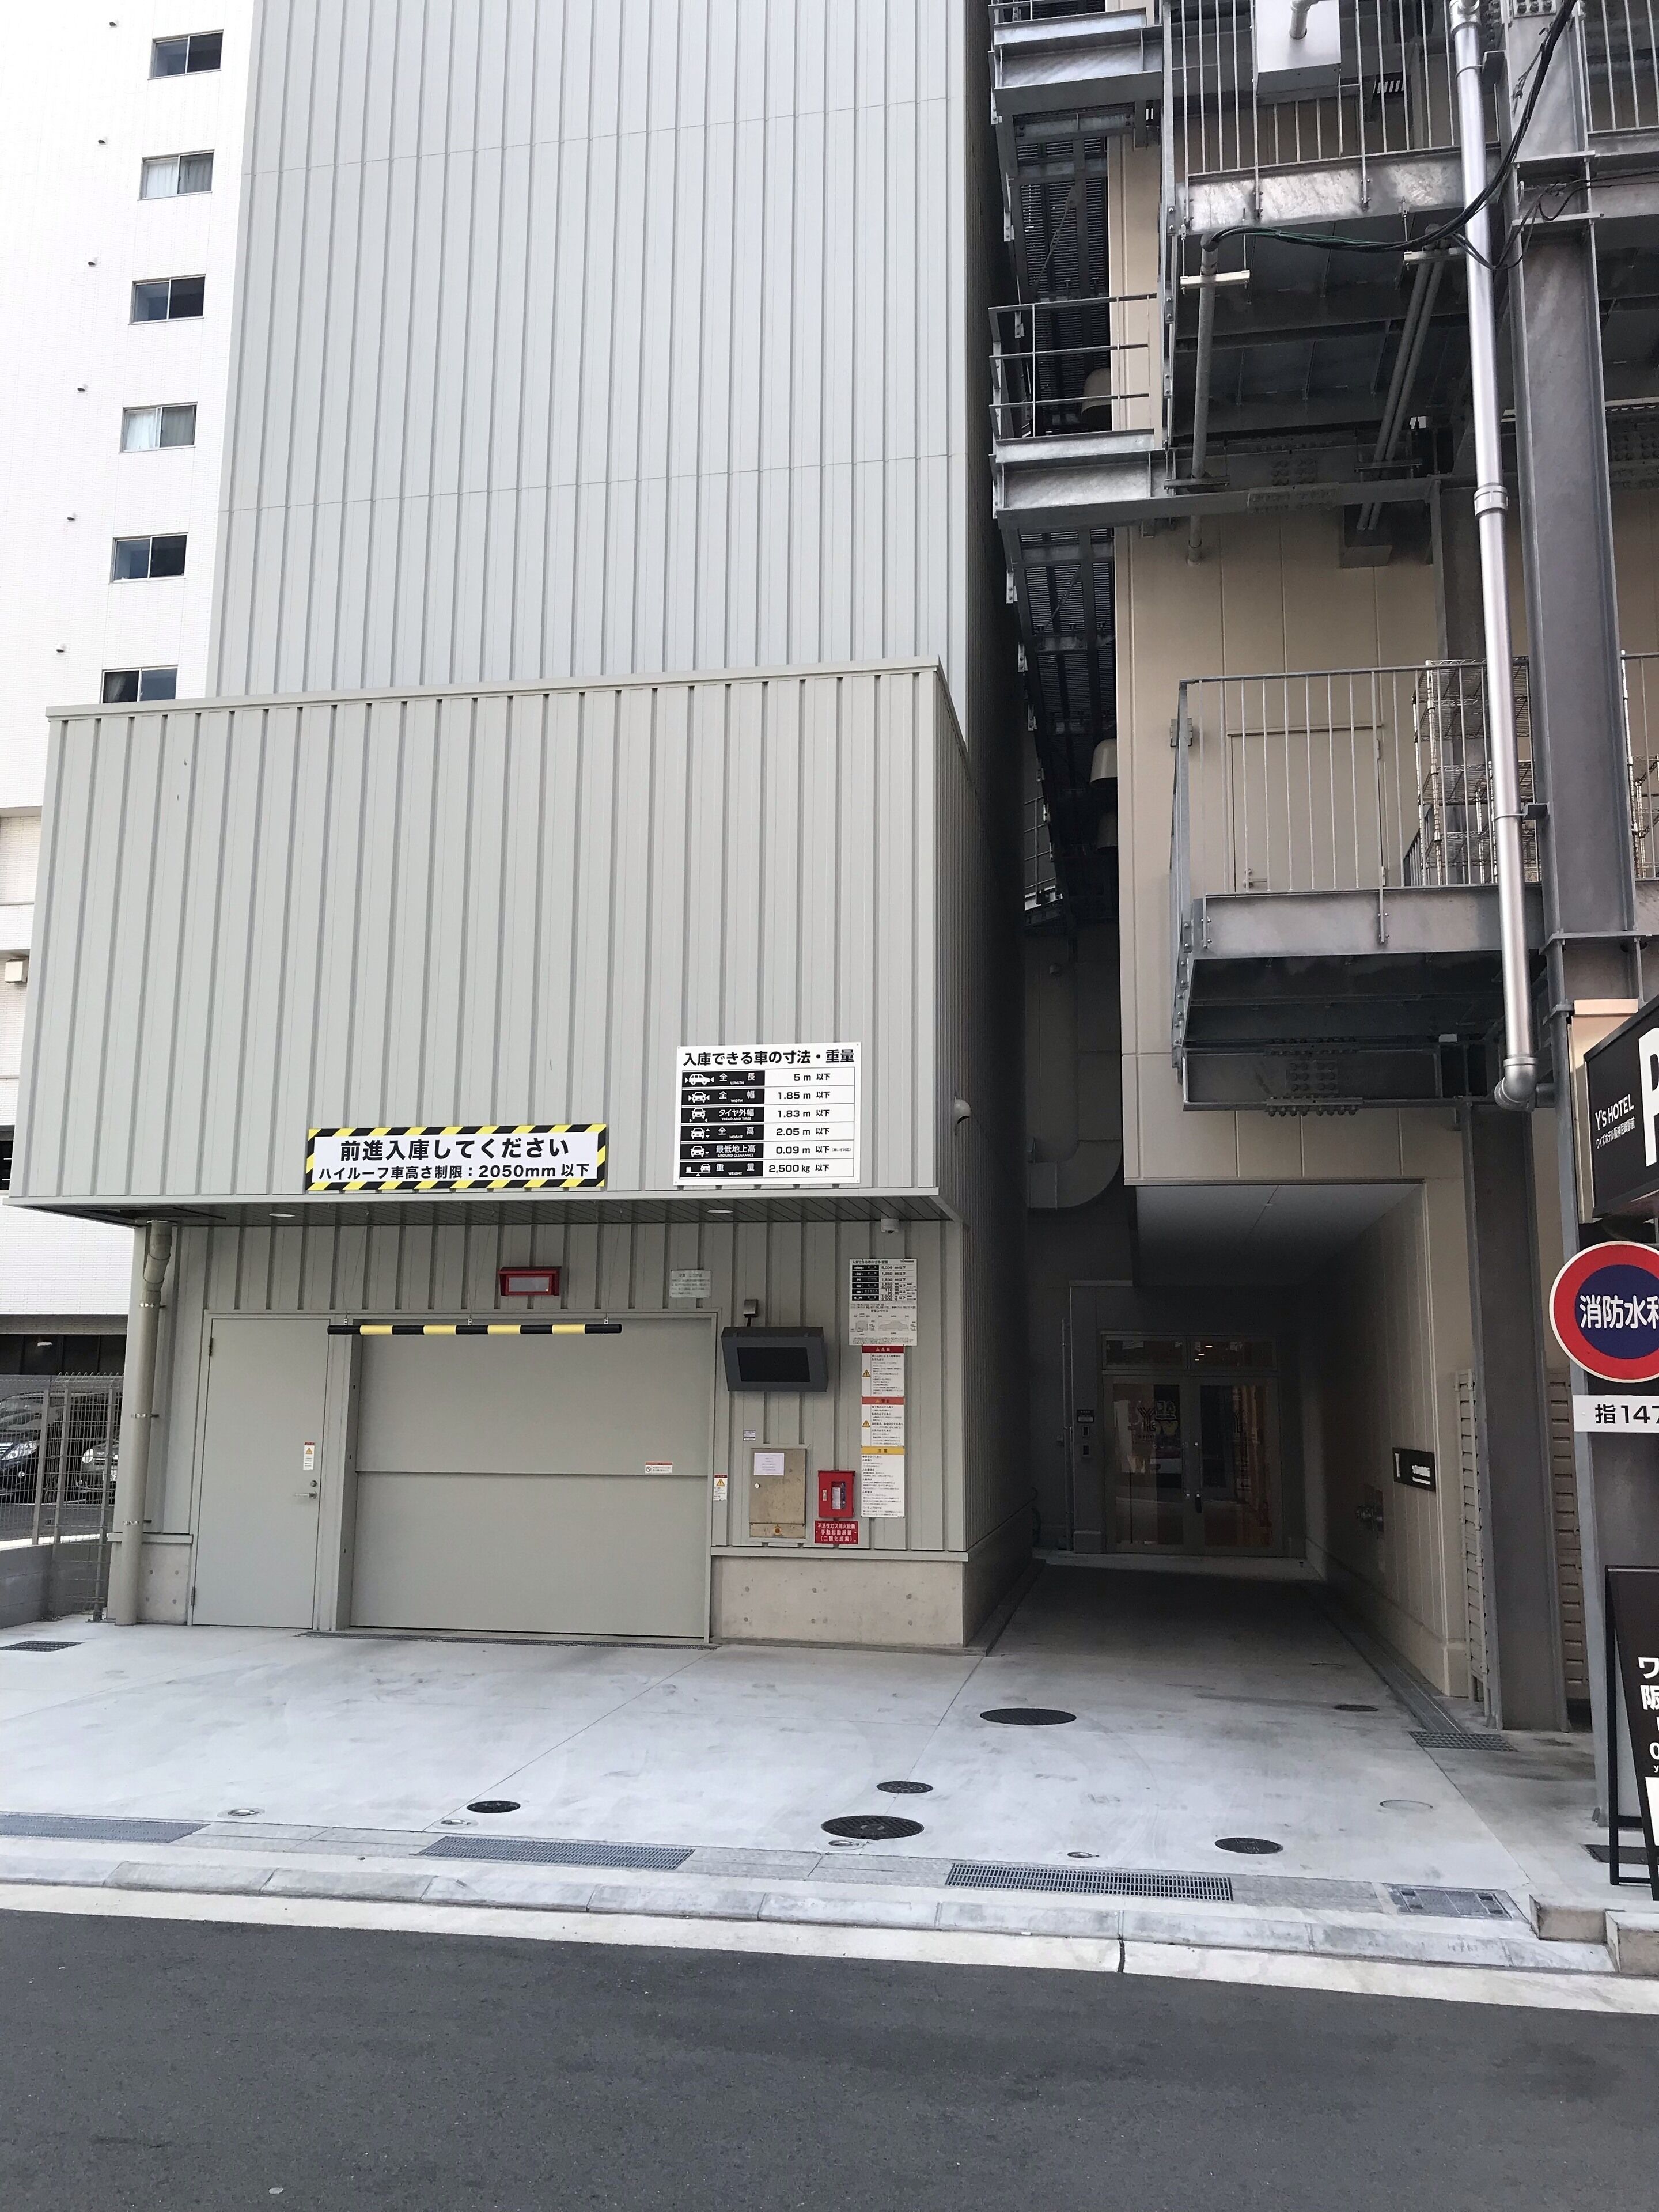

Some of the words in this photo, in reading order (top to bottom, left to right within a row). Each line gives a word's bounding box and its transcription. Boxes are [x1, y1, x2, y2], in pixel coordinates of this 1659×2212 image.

[683, 1049, 854, 1066] 入庫できる車の寸法・重量
[778, 1092, 800, 1100] 1.85
[718, 1108, 754, 1117] タイヤ外幅
[1608, 1094, 1634, 1124] HOTEL
[776, 1128, 800, 1136] 2.05
[340, 1138, 569, 1161] 前進入庫してください
[716, 1145, 756, 1153] 最低地上高
[776, 1146, 800, 1154] 0.09
[768, 1165, 800, 1173] 2,500
[802, 1165, 810, 1173] kg
